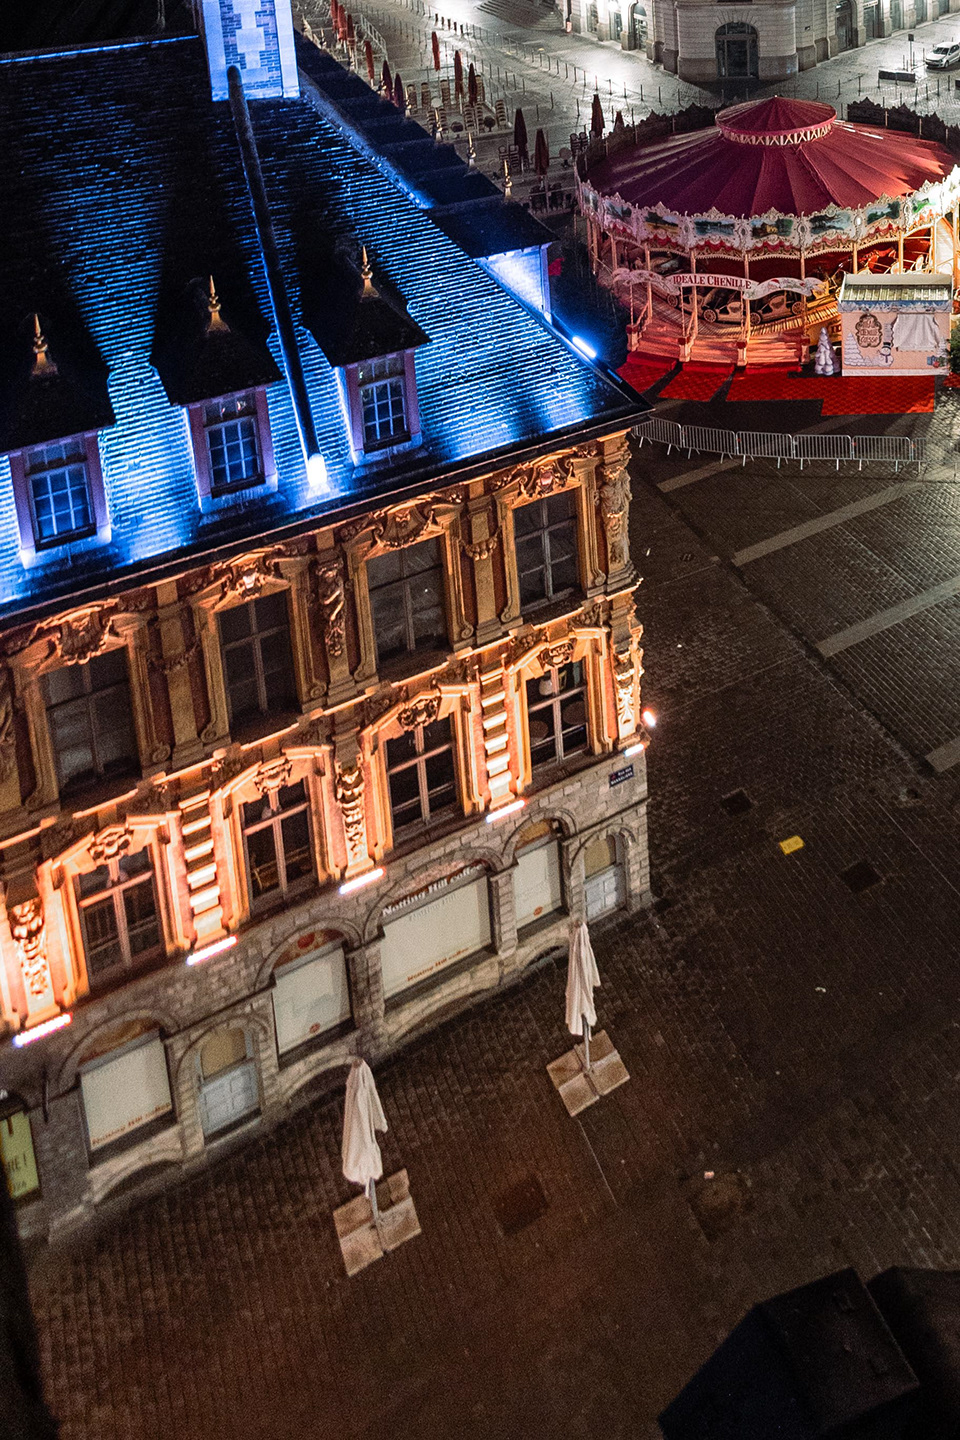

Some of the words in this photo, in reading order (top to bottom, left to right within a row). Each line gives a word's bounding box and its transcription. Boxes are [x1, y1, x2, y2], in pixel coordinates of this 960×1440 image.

[673, 275, 706, 285] IDEALE
[707, 275, 752, 290] CHENILLE
[382, 890, 426, 917] Notting
[428, 877, 448, 894] Hill
[449, 863, 484, 883] coffee
